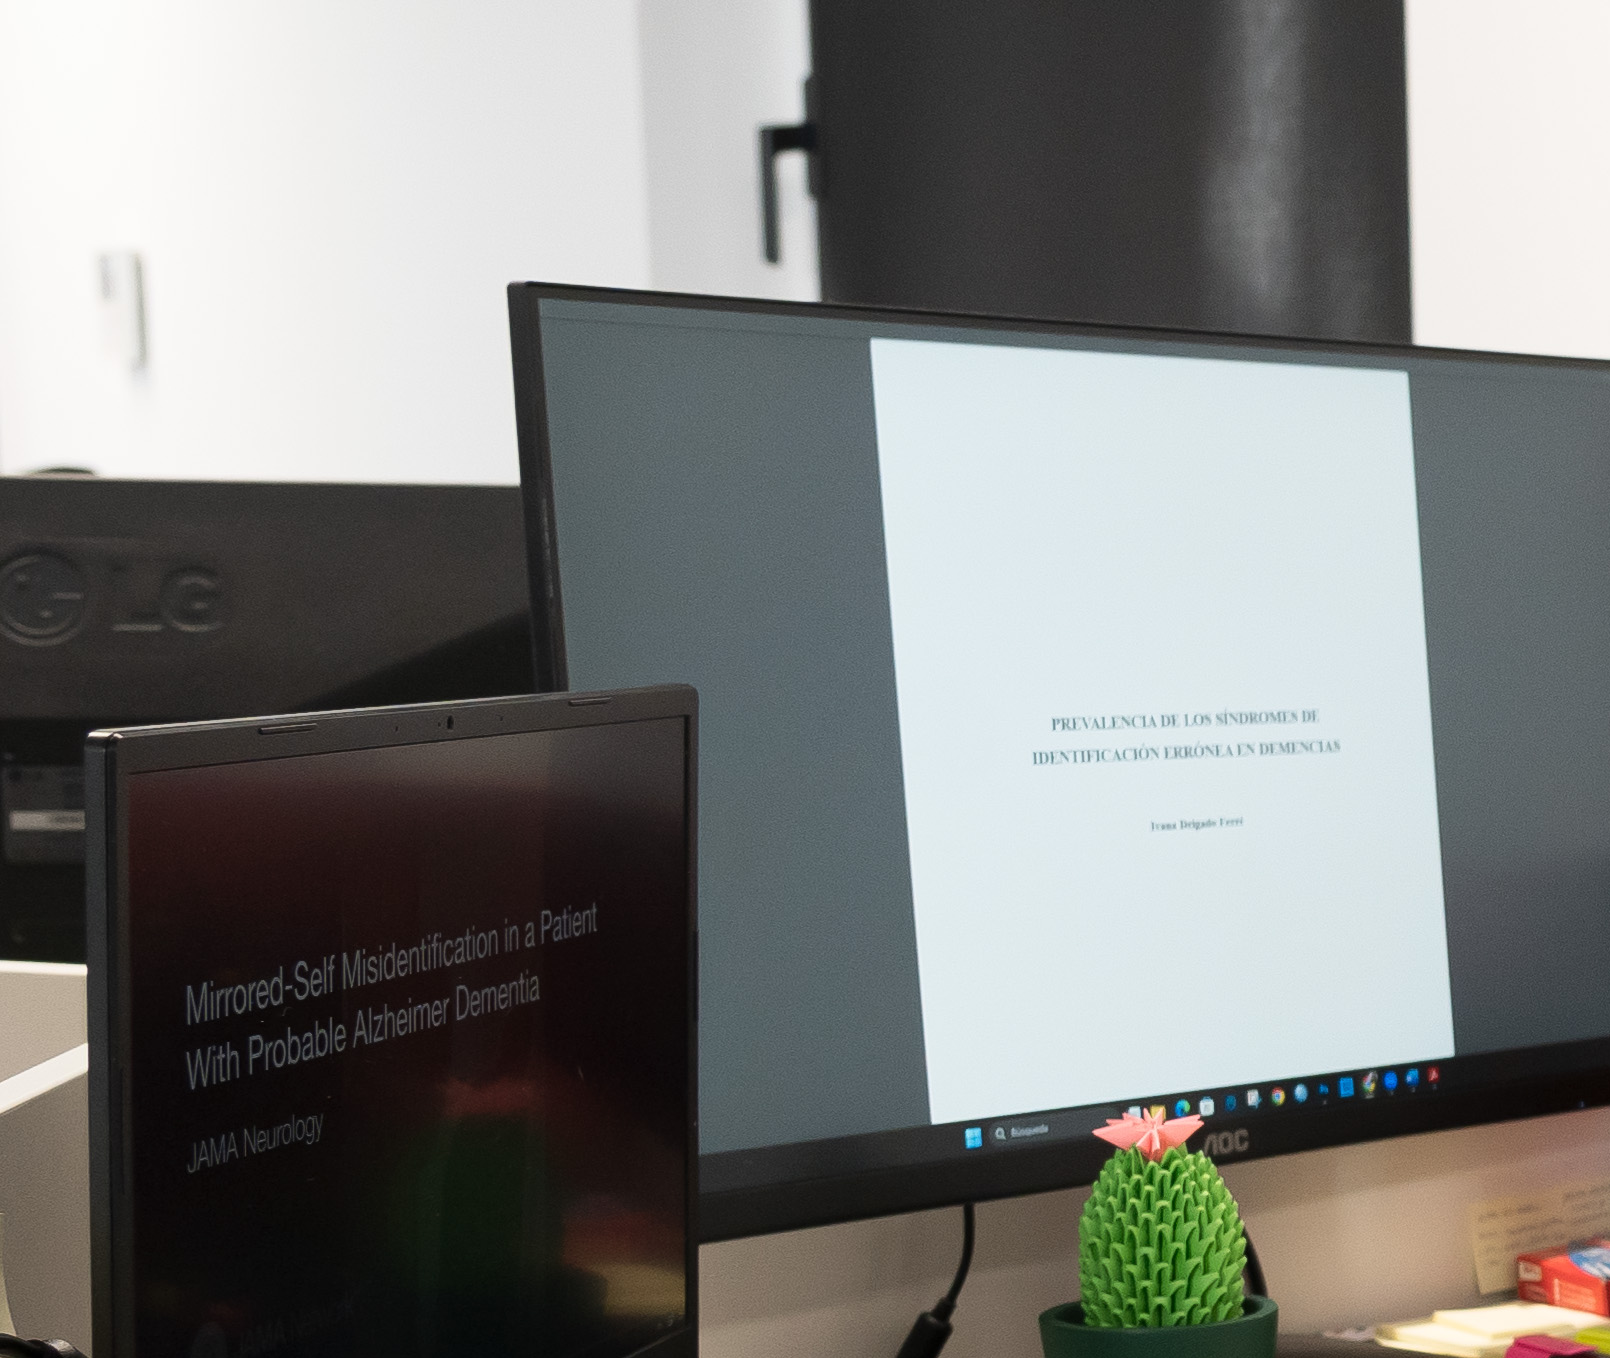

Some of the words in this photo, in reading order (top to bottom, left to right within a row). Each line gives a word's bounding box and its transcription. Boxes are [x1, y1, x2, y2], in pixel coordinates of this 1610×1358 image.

[111, 563, 224, 633] LG
[1052, 714, 1157, 731] PREVALENCIA
[1161, 714, 1180, 727] DE
[1184, 713, 1211, 726] LOS
[1215, 709, 1298, 725] SÍNDROMES
[1302, 710, 1319, 723] DE
[1033, 743, 1159, 765] IDENTIFICACIÓN
[1164, 741, 1233, 759] ERRÓNEA
[1237, 743, 1256, 756] EN
[1260, 740, 1341, 755] DEMENCIAS
[186, 955, 335, 1026] Mirrored-Self
[342, 925, 499, 991] Misidentification
[504, 918, 519, 953] in
[524, 921, 535, 948] a
[541, 902, 598, 945] Patient
[186, 1042, 239, 1090] With
[249, 1017, 346, 1075] Probable
[353, 994, 450, 1049] Alzheimer
[456, 969, 540, 1021] Dementia
[187, 1132, 238, 1173] JAMA
[244, 1114, 324, 1157] Neurology
